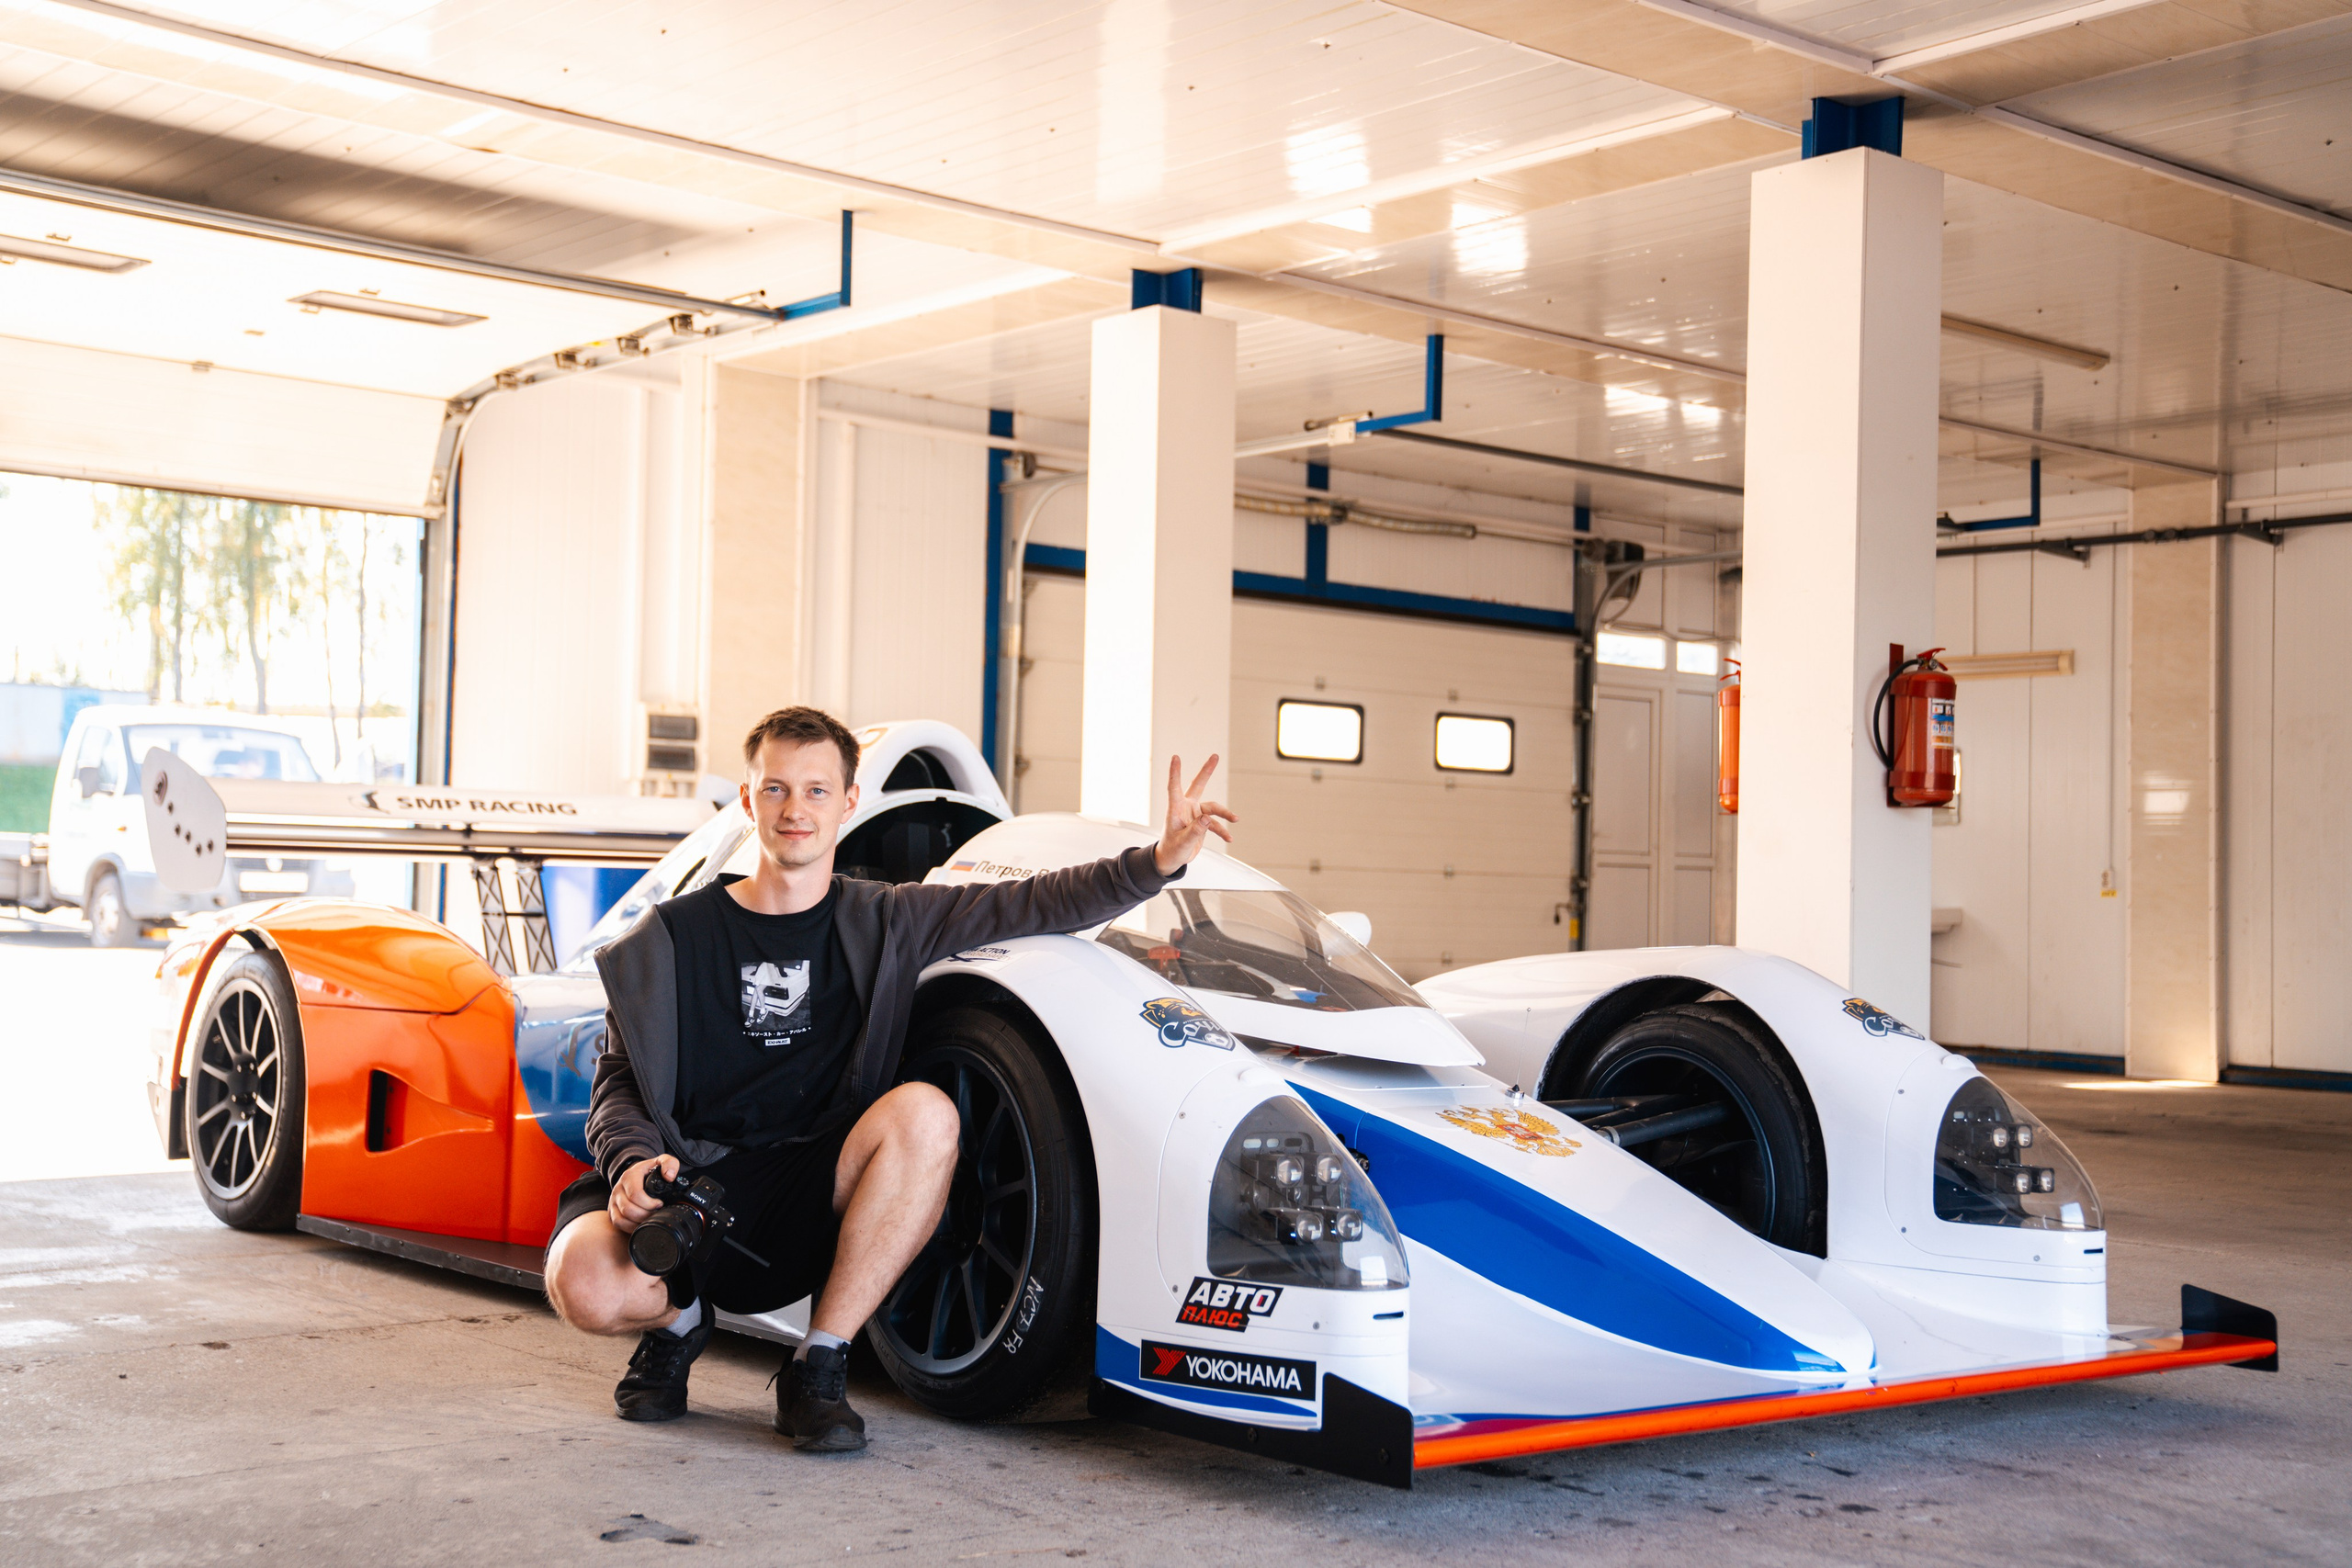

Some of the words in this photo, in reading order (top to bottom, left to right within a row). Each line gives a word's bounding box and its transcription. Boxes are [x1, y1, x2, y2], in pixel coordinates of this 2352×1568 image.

[396, 795, 460, 811] SMP
[469, 799, 578, 816] RACING
[975, 861, 1033, 878] Петров
[690, 1191, 707, 1203] SONY
[1188, 1280, 1276, 1314] АВТО
[1181, 1305, 1243, 1328] ПЛЮС
[1185, 1355, 1302, 1391] YOKOHAMA
